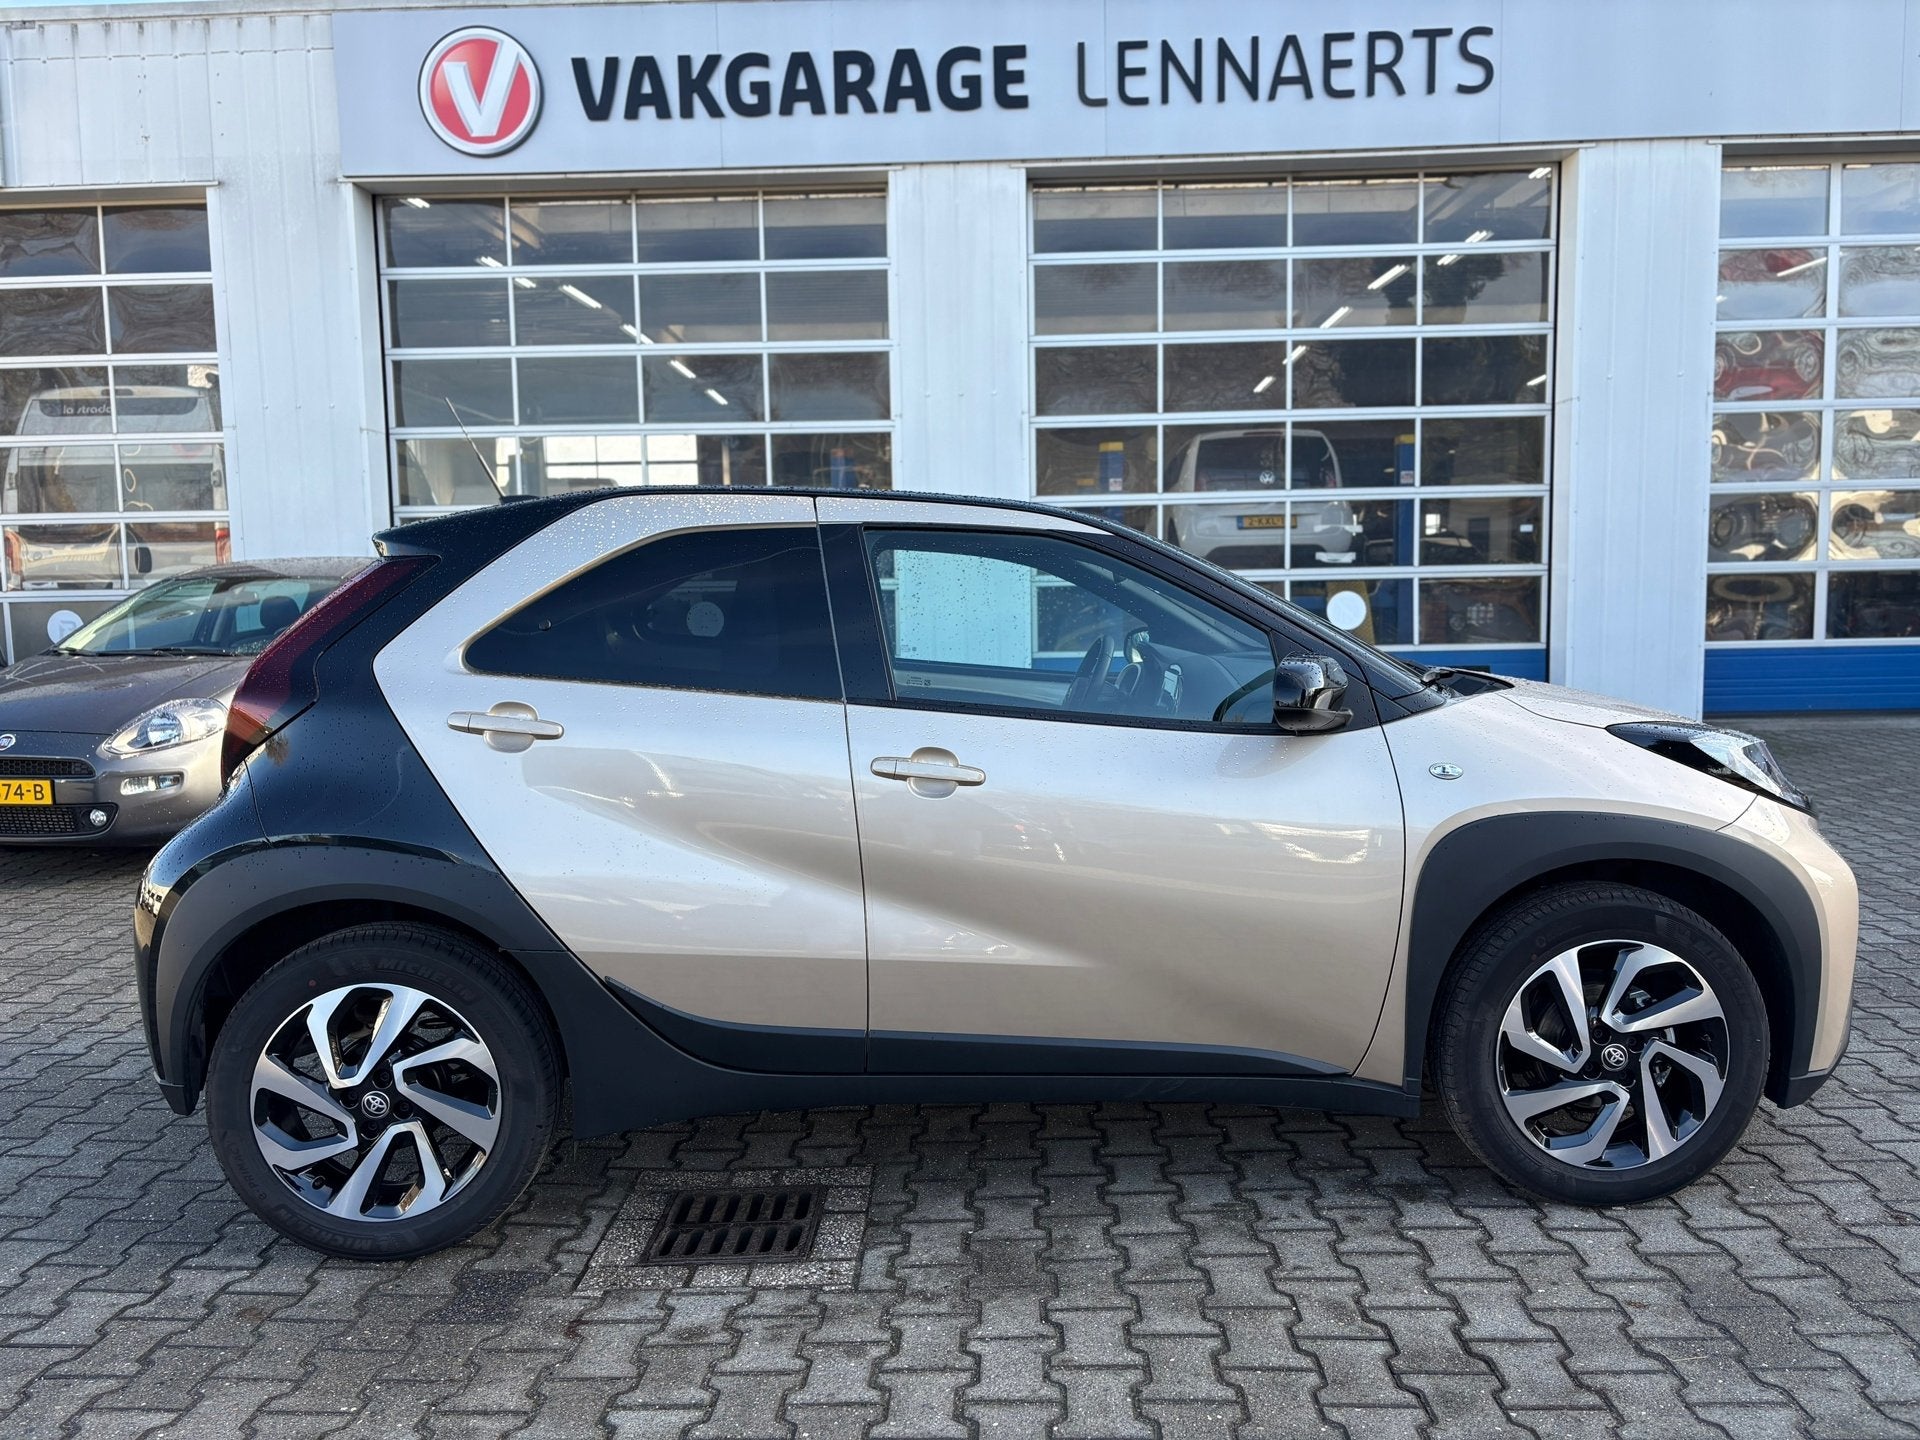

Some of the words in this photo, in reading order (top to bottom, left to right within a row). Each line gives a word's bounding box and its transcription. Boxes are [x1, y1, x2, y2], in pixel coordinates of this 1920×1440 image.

[571, 45, 1029, 121] VAKGARAGE
[1077, 26, 1494, 107] LENNAERTS
[1248, 516, 1290, 527] 2-KXL-
[0, 783, 45, 801] 74-B
